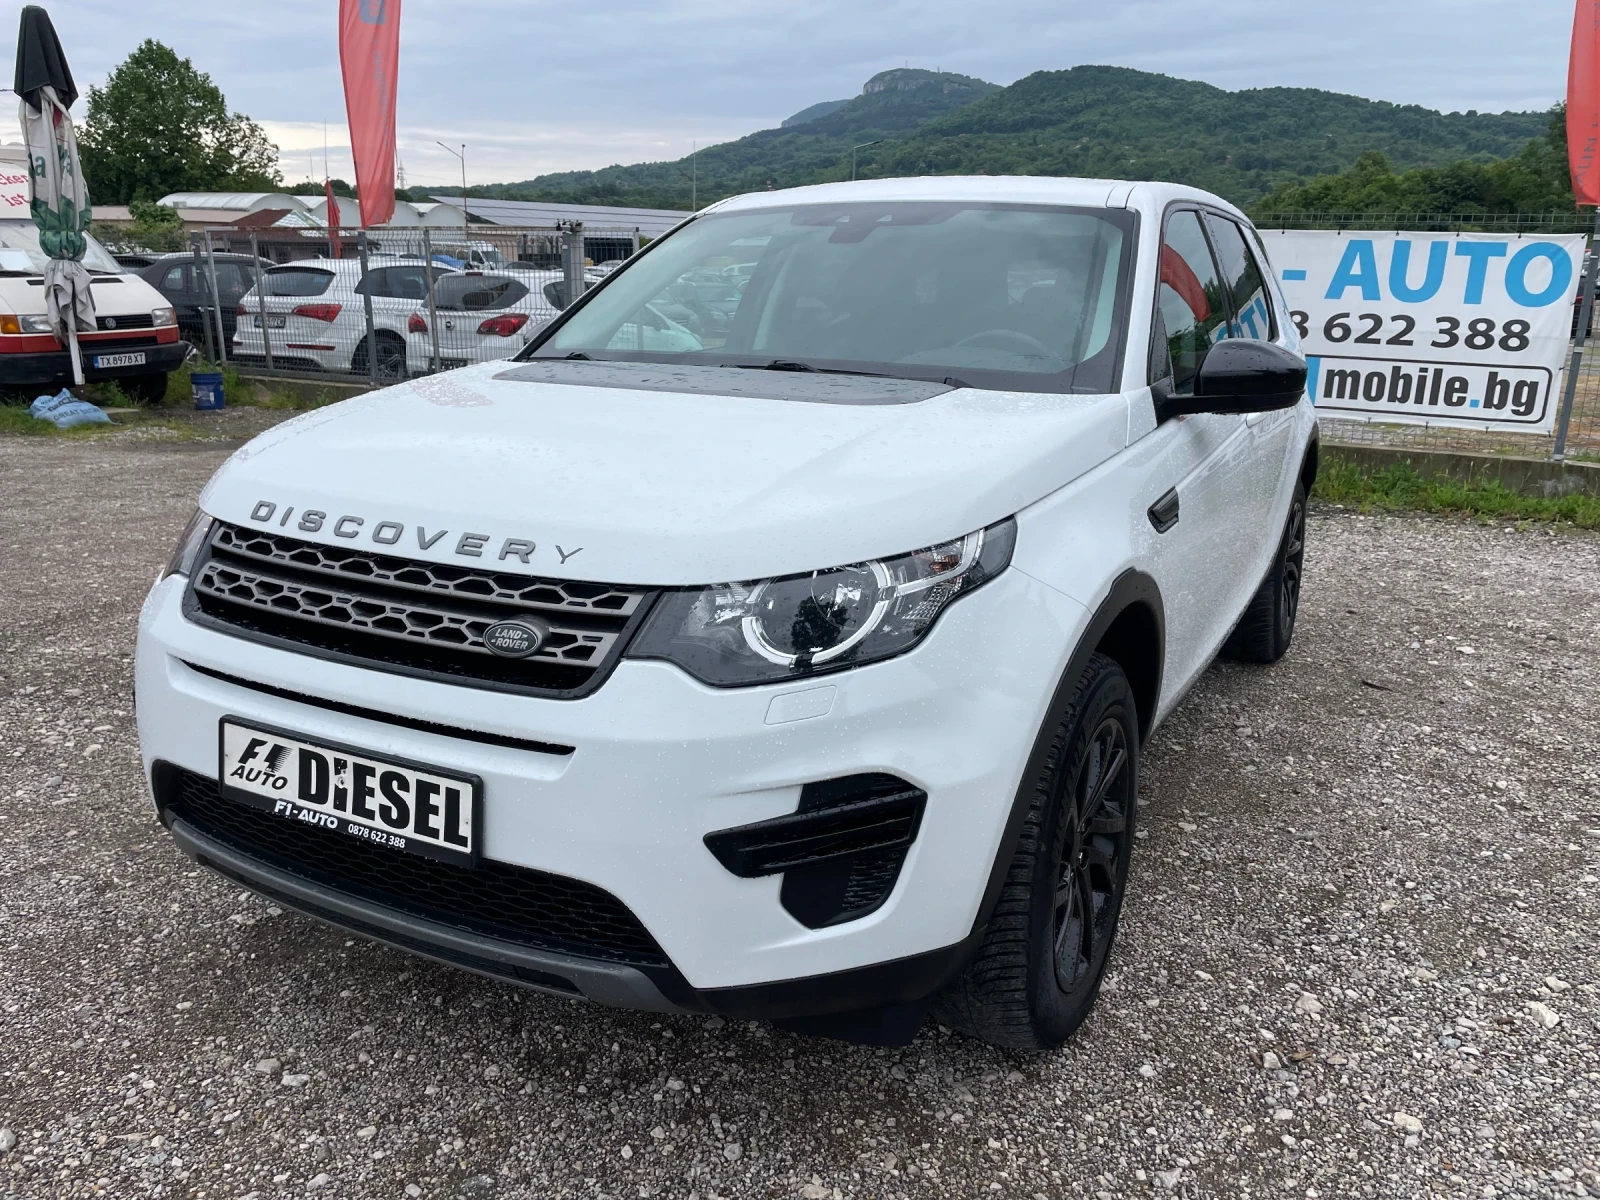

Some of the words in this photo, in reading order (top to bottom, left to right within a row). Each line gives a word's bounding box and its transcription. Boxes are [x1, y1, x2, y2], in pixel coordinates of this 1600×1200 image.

[1324, 239, 1573, 307] AUTO
[1323, 312, 1416, 346] 622
[1430, 316, 1530, 351] 388
[100, 356, 111, 366] TX
[113, 355, 132, 365] 8978
[134, 353, 143, 364] XT
[1323, 366, 1539, 416] mobile.bg
[250, 499, 584, 565] DISCOVERY
[237, 737, 293, 773] F1
[230, 764, 288, 790] AUTO
[297, 746, 468, 848] DIESEL
[348, 823, 369, 838] 0878
[370, 830, 387, 843] 622
[388, 835, 405, 848] 388
